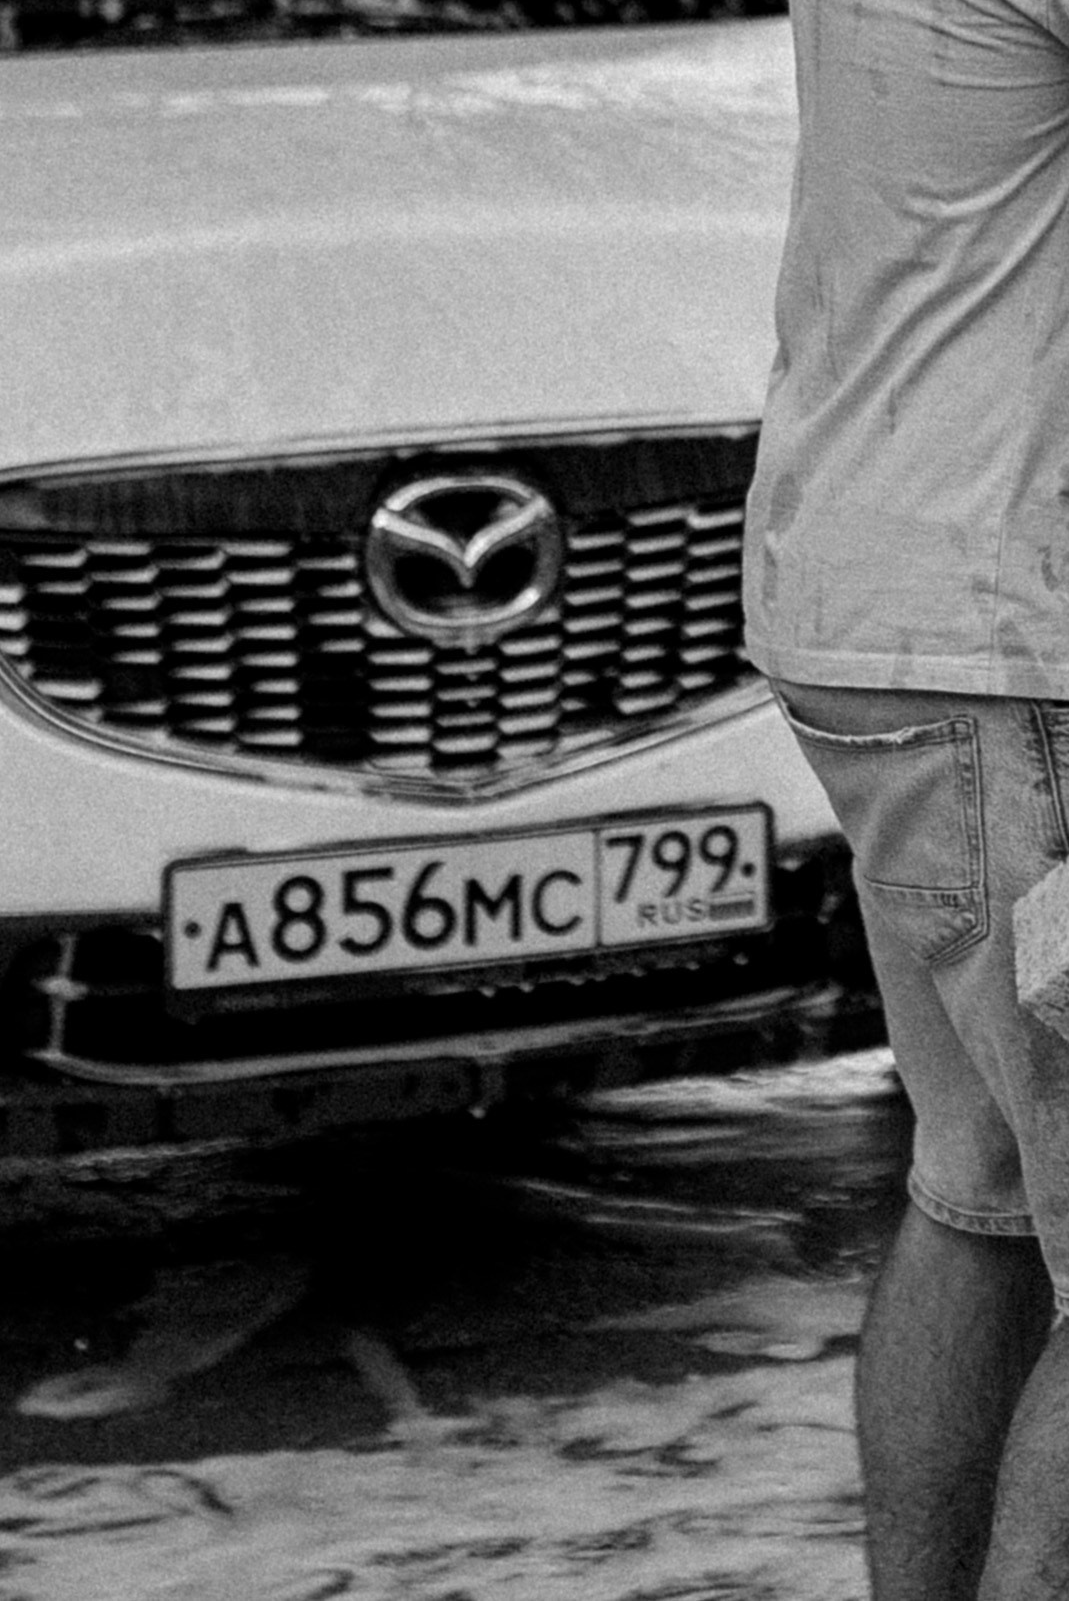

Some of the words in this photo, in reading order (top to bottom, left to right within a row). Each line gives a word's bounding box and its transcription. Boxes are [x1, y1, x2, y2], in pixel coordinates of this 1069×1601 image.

[605, 824, 739, 903] 799
[207, 861, 583, 971] A856MC
[635, 897, 704, 928] RUS
